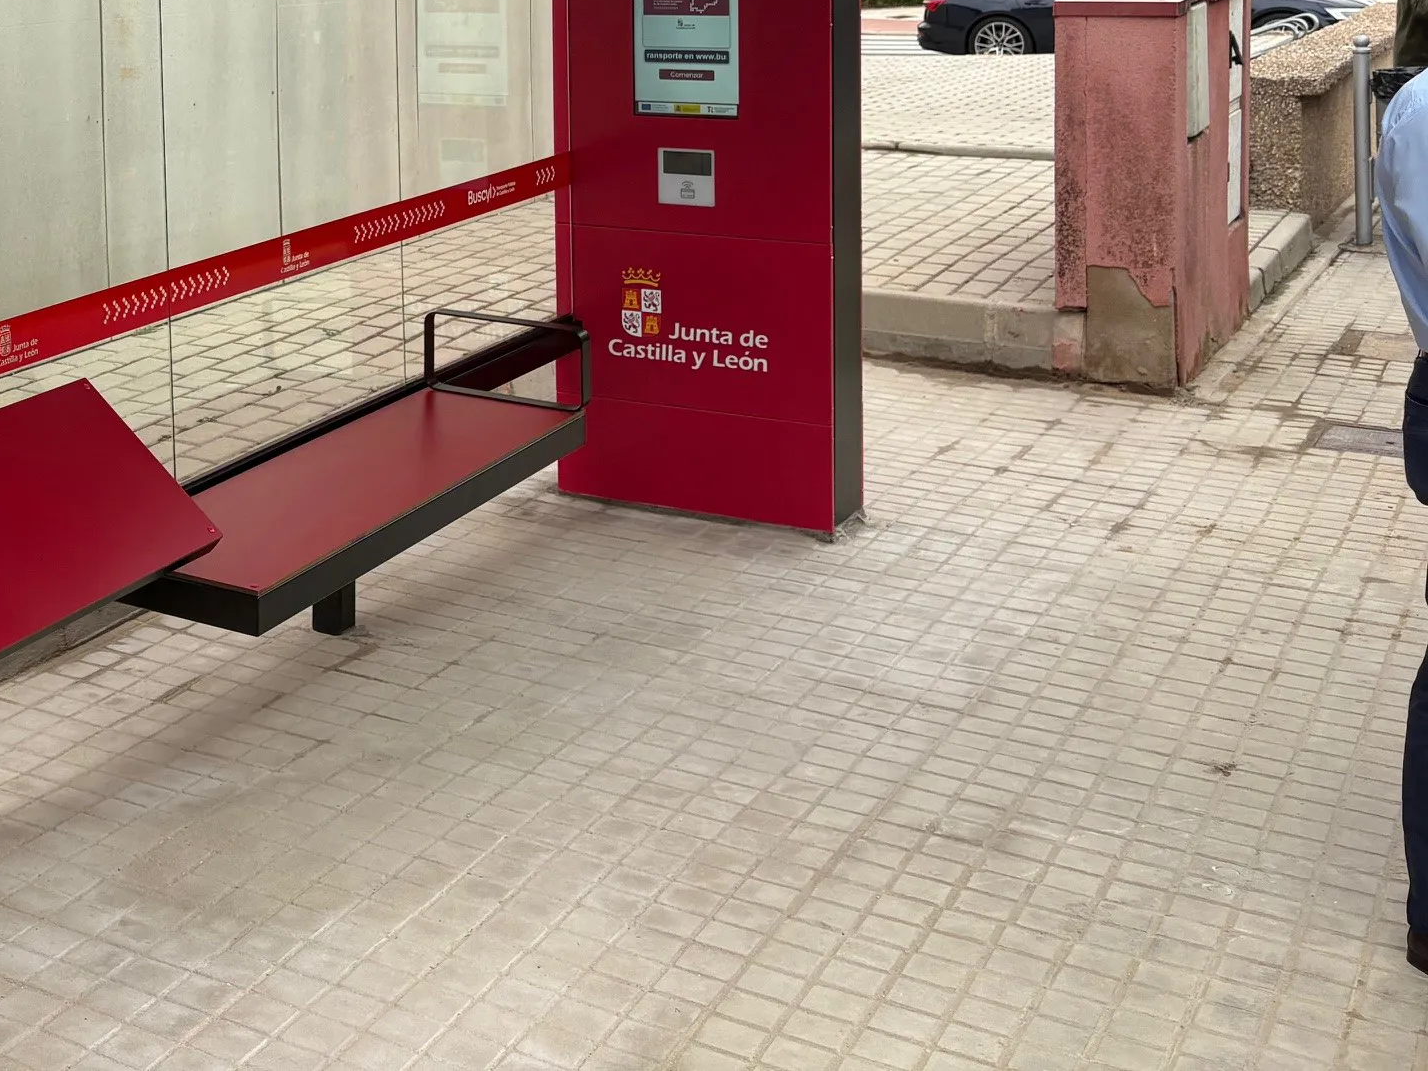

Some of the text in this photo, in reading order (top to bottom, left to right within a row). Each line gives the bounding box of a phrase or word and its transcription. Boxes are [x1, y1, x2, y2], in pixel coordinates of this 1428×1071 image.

[670, 71, 703, 79] Comenzar
[468, 183, 492, 205] Buscyl
[668, 322, 769, 349] Junta de
[13, 338, 38, 352] Junta de
[19, 354, 23, 363] y
[24, 348, 38, 358] León
[608, 339, 768, 372] Castilla y León
